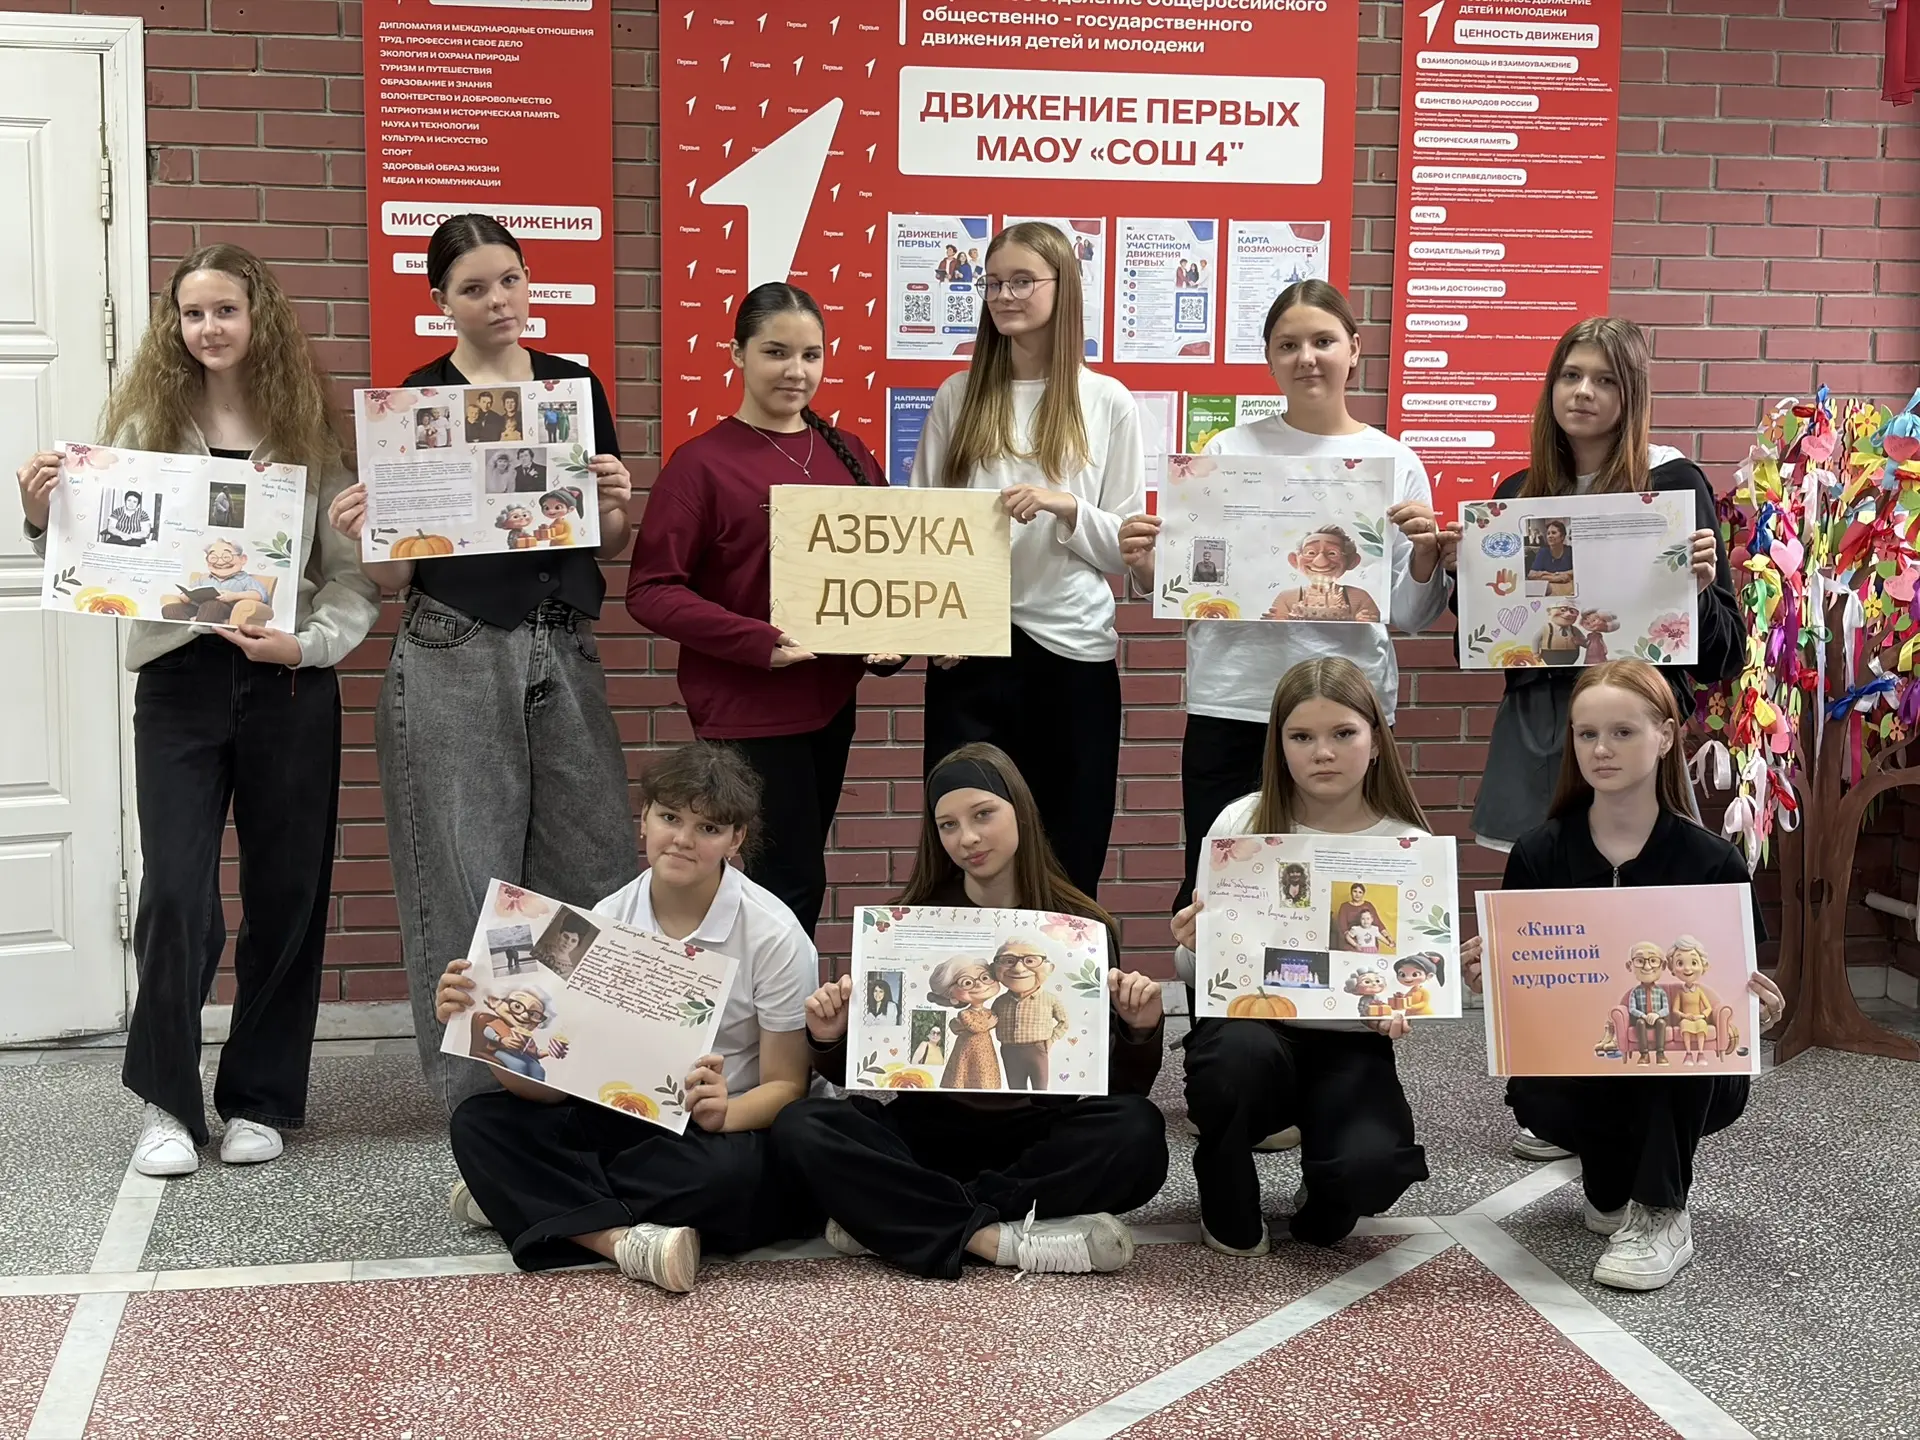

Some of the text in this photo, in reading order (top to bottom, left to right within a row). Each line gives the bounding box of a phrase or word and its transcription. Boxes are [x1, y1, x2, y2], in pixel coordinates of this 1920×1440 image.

[1459, 5, 1567, 17] ДЕТЕЙ И МОЛОДЕЖИ
[922, 6, 1060, 25] общественно
[1077, 14, 1253, 33] государственного
[379, 22, 594, 36] ДИПЛОМАТИЯ И МЕЖДУНАРОДНЫЕ ОТНОШЕНИЯ
[1460, 29, 1593, 41] ЦЕННОСТЬ ДВИЖЕНИЯ
[380, 36, 523, 48] ТРУД, ПРОФЕССИЯ И СВОЕ ДЕЛО
[922, 32, 1205, 54] движения детей и молодежи
[380, 50, 428, 59] ЭКОЛОГИЯ
[438, 52, 473, 60] ОХРАНА
[475, 53, 519, 61] ПРИРОДЫ
[1422, 58, 1490, 66] ВЗАИМОПОМОЩЬ
[1498, 60, 1571, 68] ВЗАИМОУВАЖЕНИЕ
[380, 64, 492, 75] ТУРИЗМ И ПУТЕШЕСТВИЯ
[380, 78, 446, 87] ОБРАЗОВАНИЕ
[456, 80, 492, 88] ЗНАНИЯ
[381, 92, 552, 105] ВОЛОНТЕРСТВО И ДОБРОВОЛЬЧЕСТВО
[381, 106, 560, 119] ПАТРИОТИЗМ И ИСТОРИЧЕСКАЯ ПАМЯТЬ
[920, 92, 1300, 127] ДВИЖЕНИЕ ПЕРВЫХ
[382, 120, 480, 130] НАУКА И ТЕХНОЛОГИИ
[382, 134, 488, 144] КУЛЬТУРА И ИСКУССТВО
[382, 148, 412, 156] СПОРТ
[977, 136, 1082, 164] МАОУ
[1091, 139, 1195, 167] «СОШ
[382, 162, 499, 172] ЗДОРОВЫЙ ОБРАЗ ЖИЗНИ
[383, 176, 501, 187] МЕДИА И КОММУНИКАЦИИ
[1452, 173, 1522, 181] СПРАВЕДЛИВОСТЬ
[391, 213, 593, 230] МИСС ВИЖЕНИЯ
[898, 231, 958, 239] ДВИЖЕНИЕ
[1126, 233, 1145, 241] КАК
[1238, 236, 1269, 244] КАРТА
[897, 240, 941, 248] ПЕРВЫХ
[1126, 242, 1190, 250] УЧАСТНИКОМ
[1238, 245, 1318, 253] ВОЗМОЖНОСТЕЙ
[1126, 251, 1181, 259] ДВИЖЕНИЯ
[1414, 247, 1480, 255] СОЗИДАТЕЛЬНЫЙ
[406, 260, 428, 269] БЫТ
[808, 514, 974, 556] АЗБУКА
[816, 579, 967, 625] ДОБРА
[1517, 922, 1585, 936] «Книга
[1512, 944, 1600, 961] семейной
[1512, 971, 1609, 989] мудрости»
